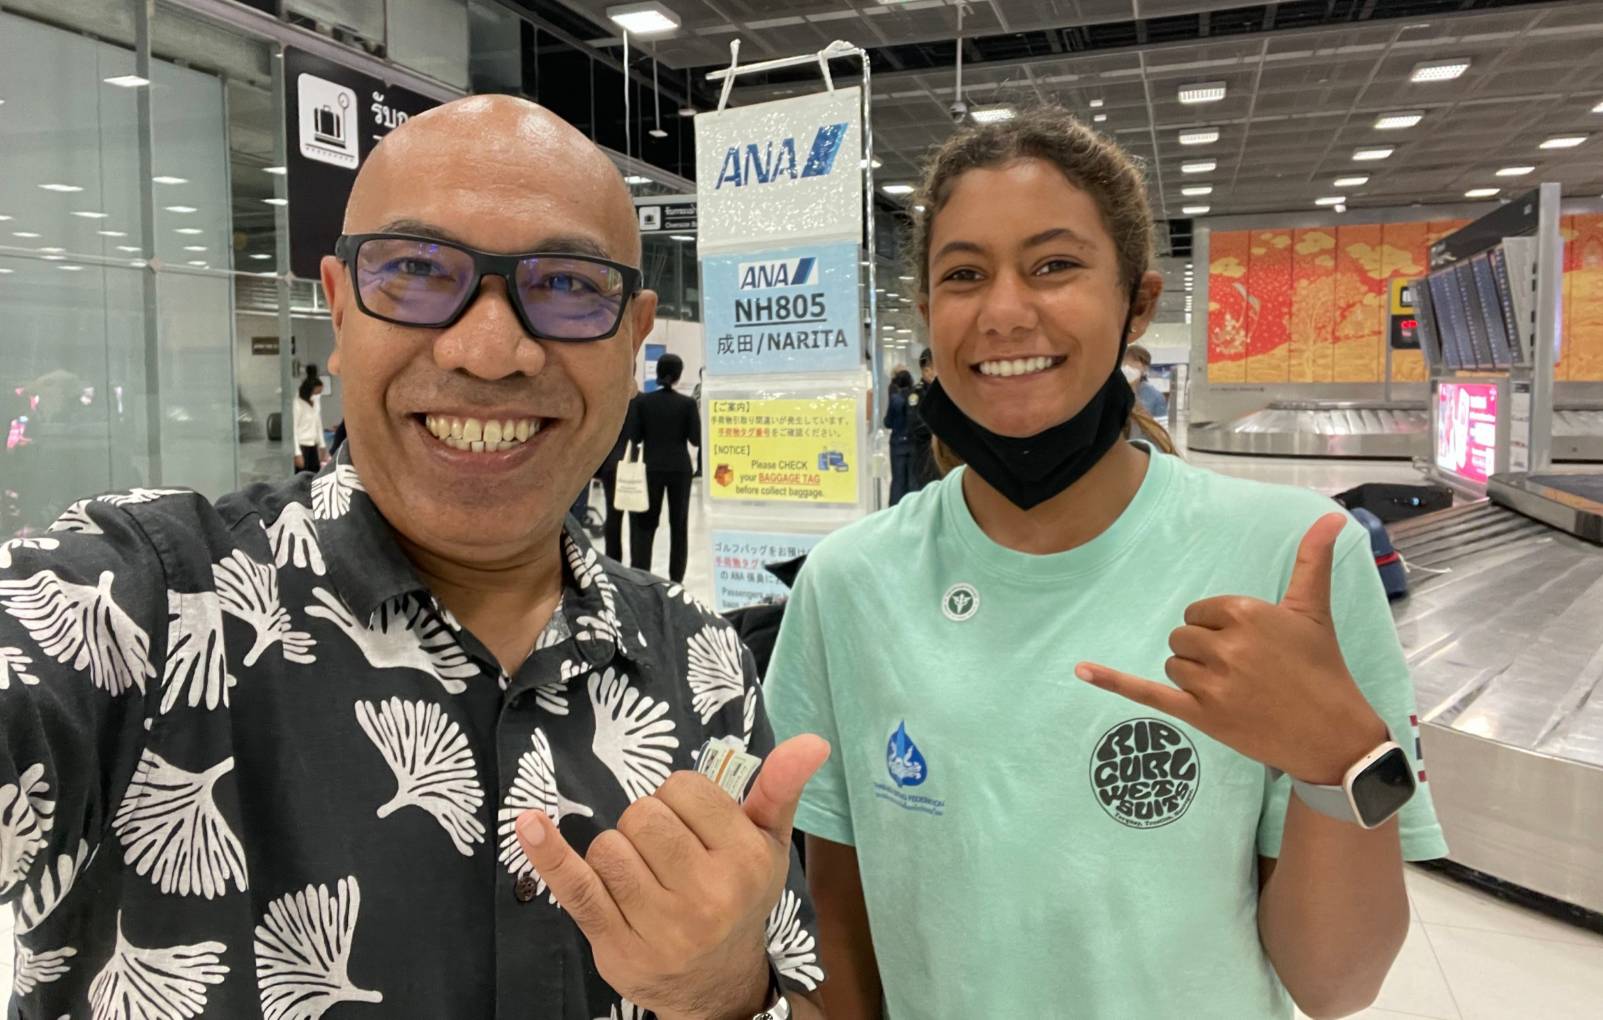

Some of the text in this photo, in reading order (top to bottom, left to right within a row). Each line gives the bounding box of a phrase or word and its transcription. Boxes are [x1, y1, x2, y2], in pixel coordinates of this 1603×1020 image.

[715, 138, 798, 190] ANA
[740, 263, 789, 290] ANA
[735, 293, 826, 322] NH805
[717, 329, 848, 355] 成田/NARITA
[751, 460, 808, 470] Please CHECK
[740, 474, 820, 484] your BAGGAGE TAG
[735, 487, 824, 499] before collect baggage.
[1097, 721, 1181, 762] RIP
[1094, 747, 1196, 789] CURL
